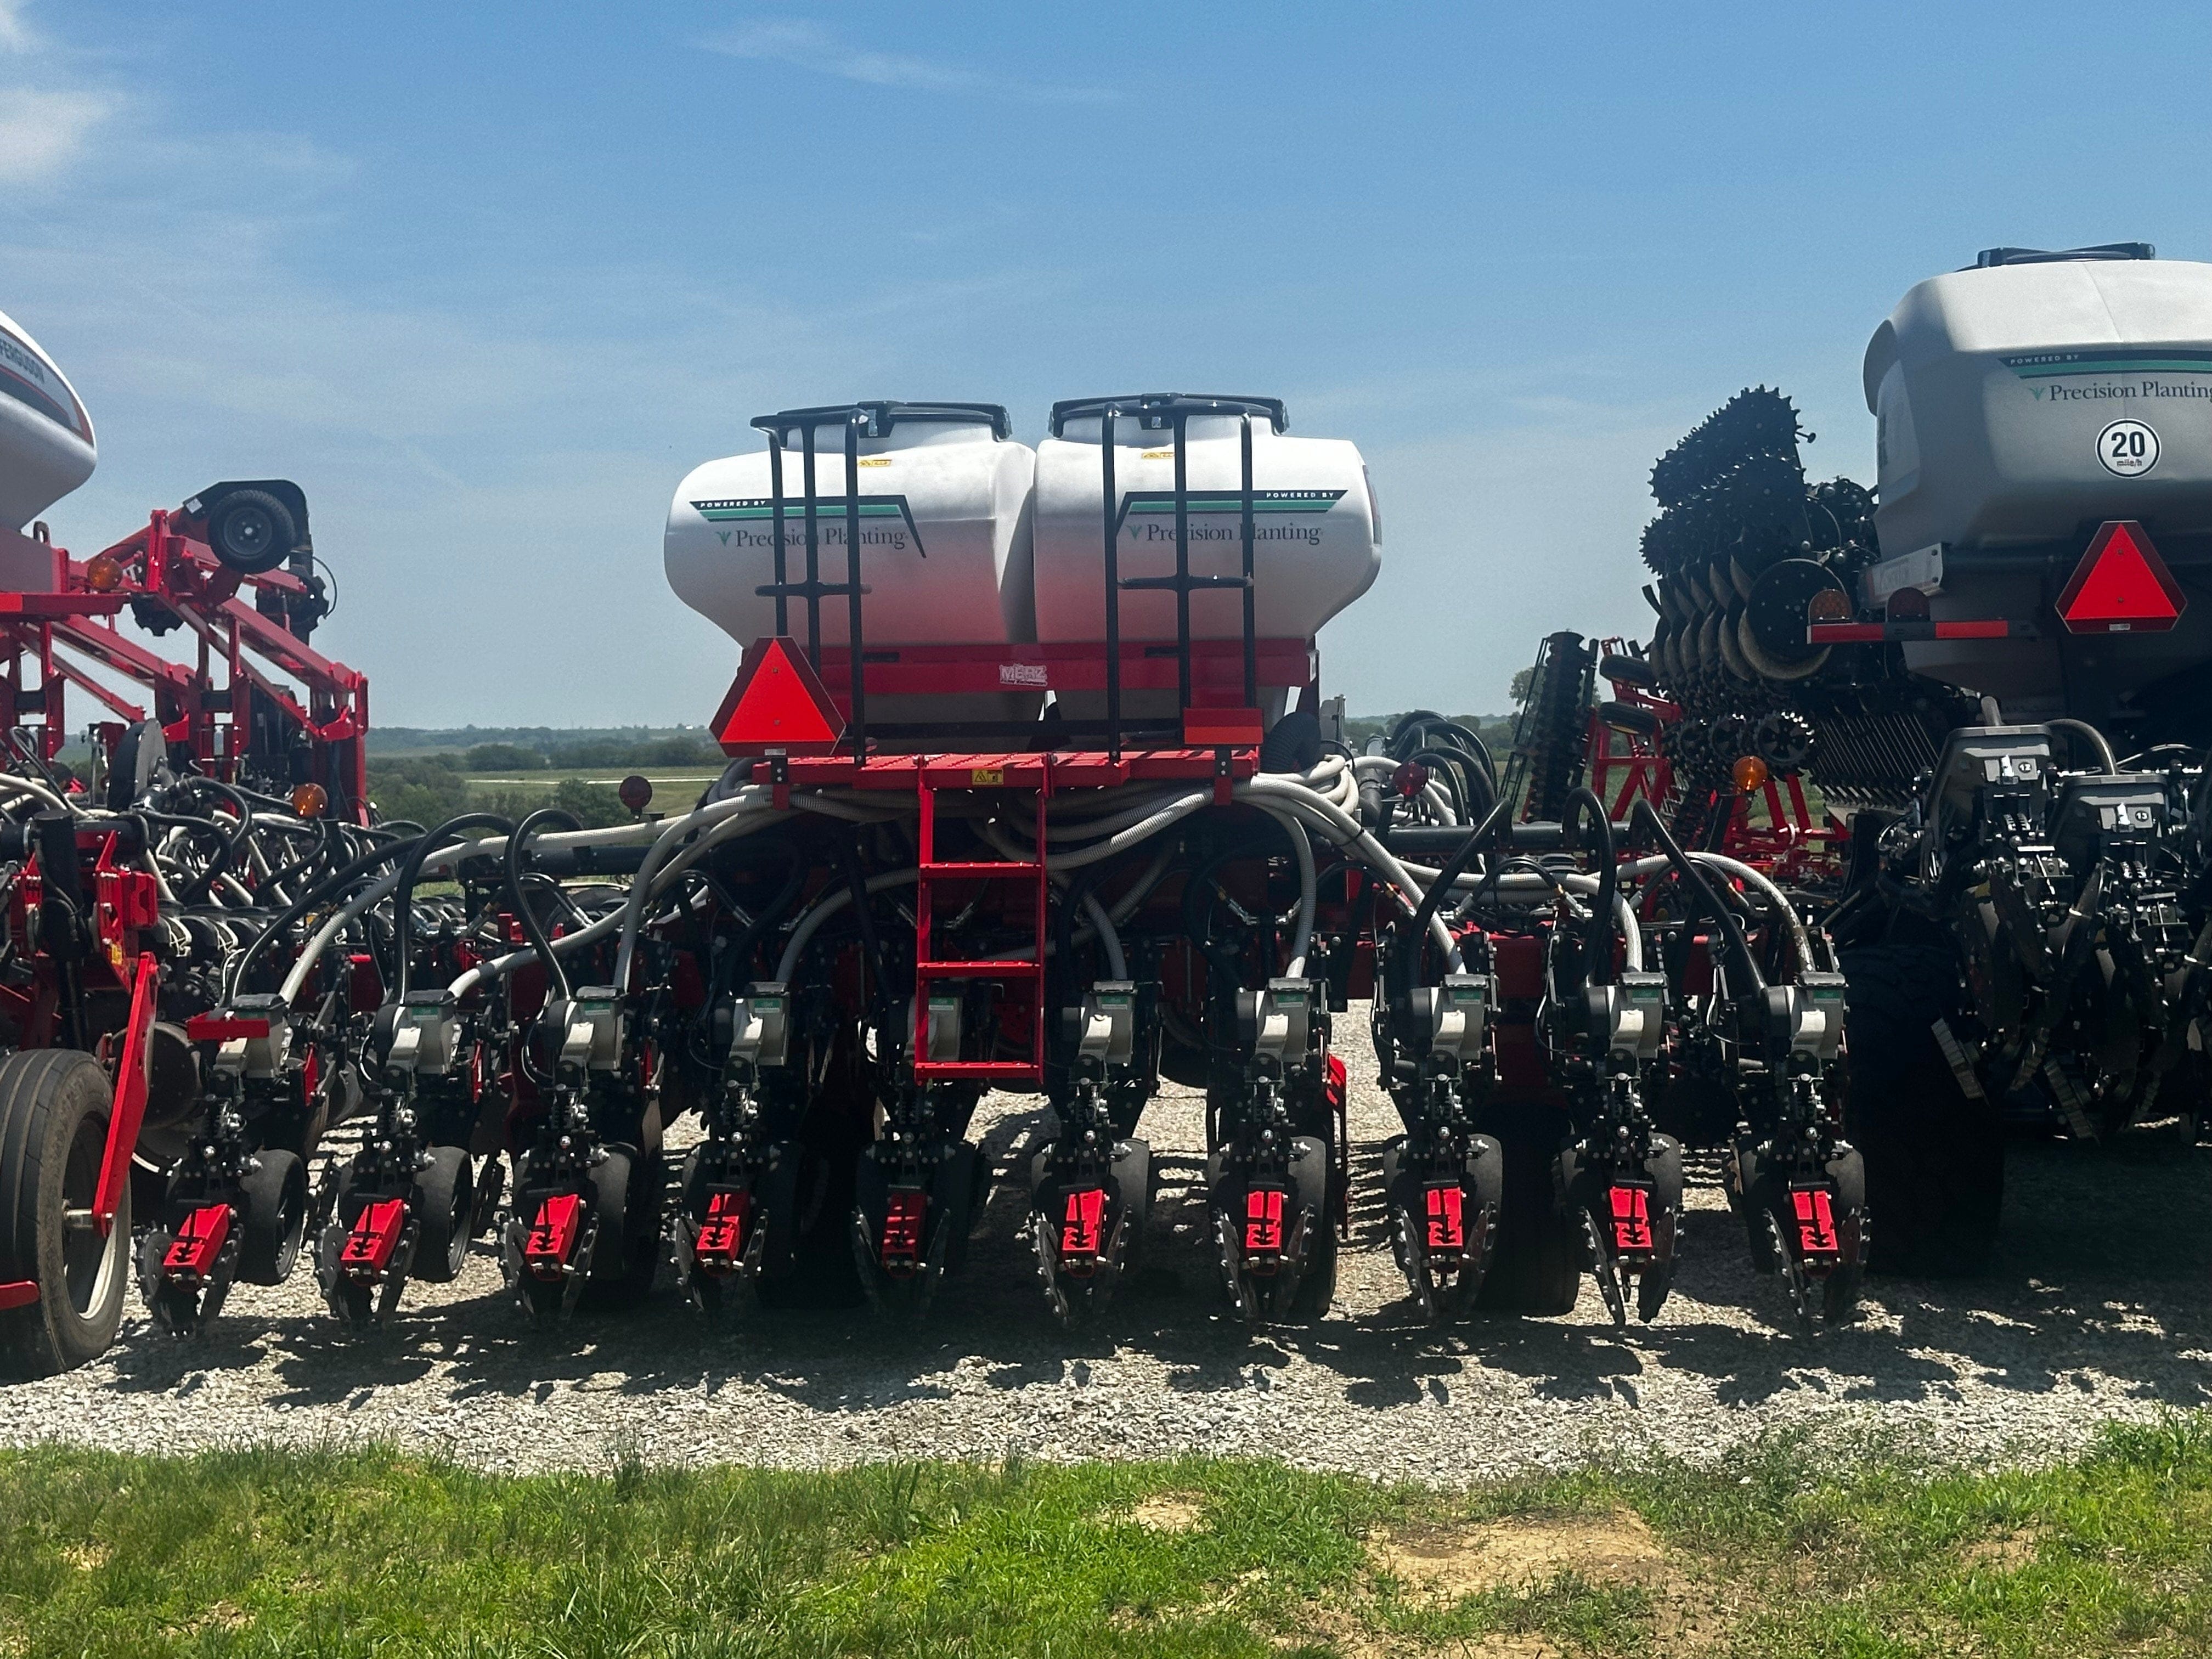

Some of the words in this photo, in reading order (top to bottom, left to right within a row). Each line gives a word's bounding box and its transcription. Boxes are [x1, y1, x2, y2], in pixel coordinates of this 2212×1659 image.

[2010, 356, 2061, 365] POWERED
[2050, 382, 2137, 401] Precision
[2141, 381, 2212, 403] Plantin
[2111, 431, 2146, 457] 20
[2117, 459, 2142, 467] mile/h
[1147, 523, 1233, 541] Preision
[1239, 522, 1321, 545] lanting
[1001, 666, 1046, 680] MERZ
[2019, 763, 2031, 771] 12
[2136, 812, 2148, 820] 13
